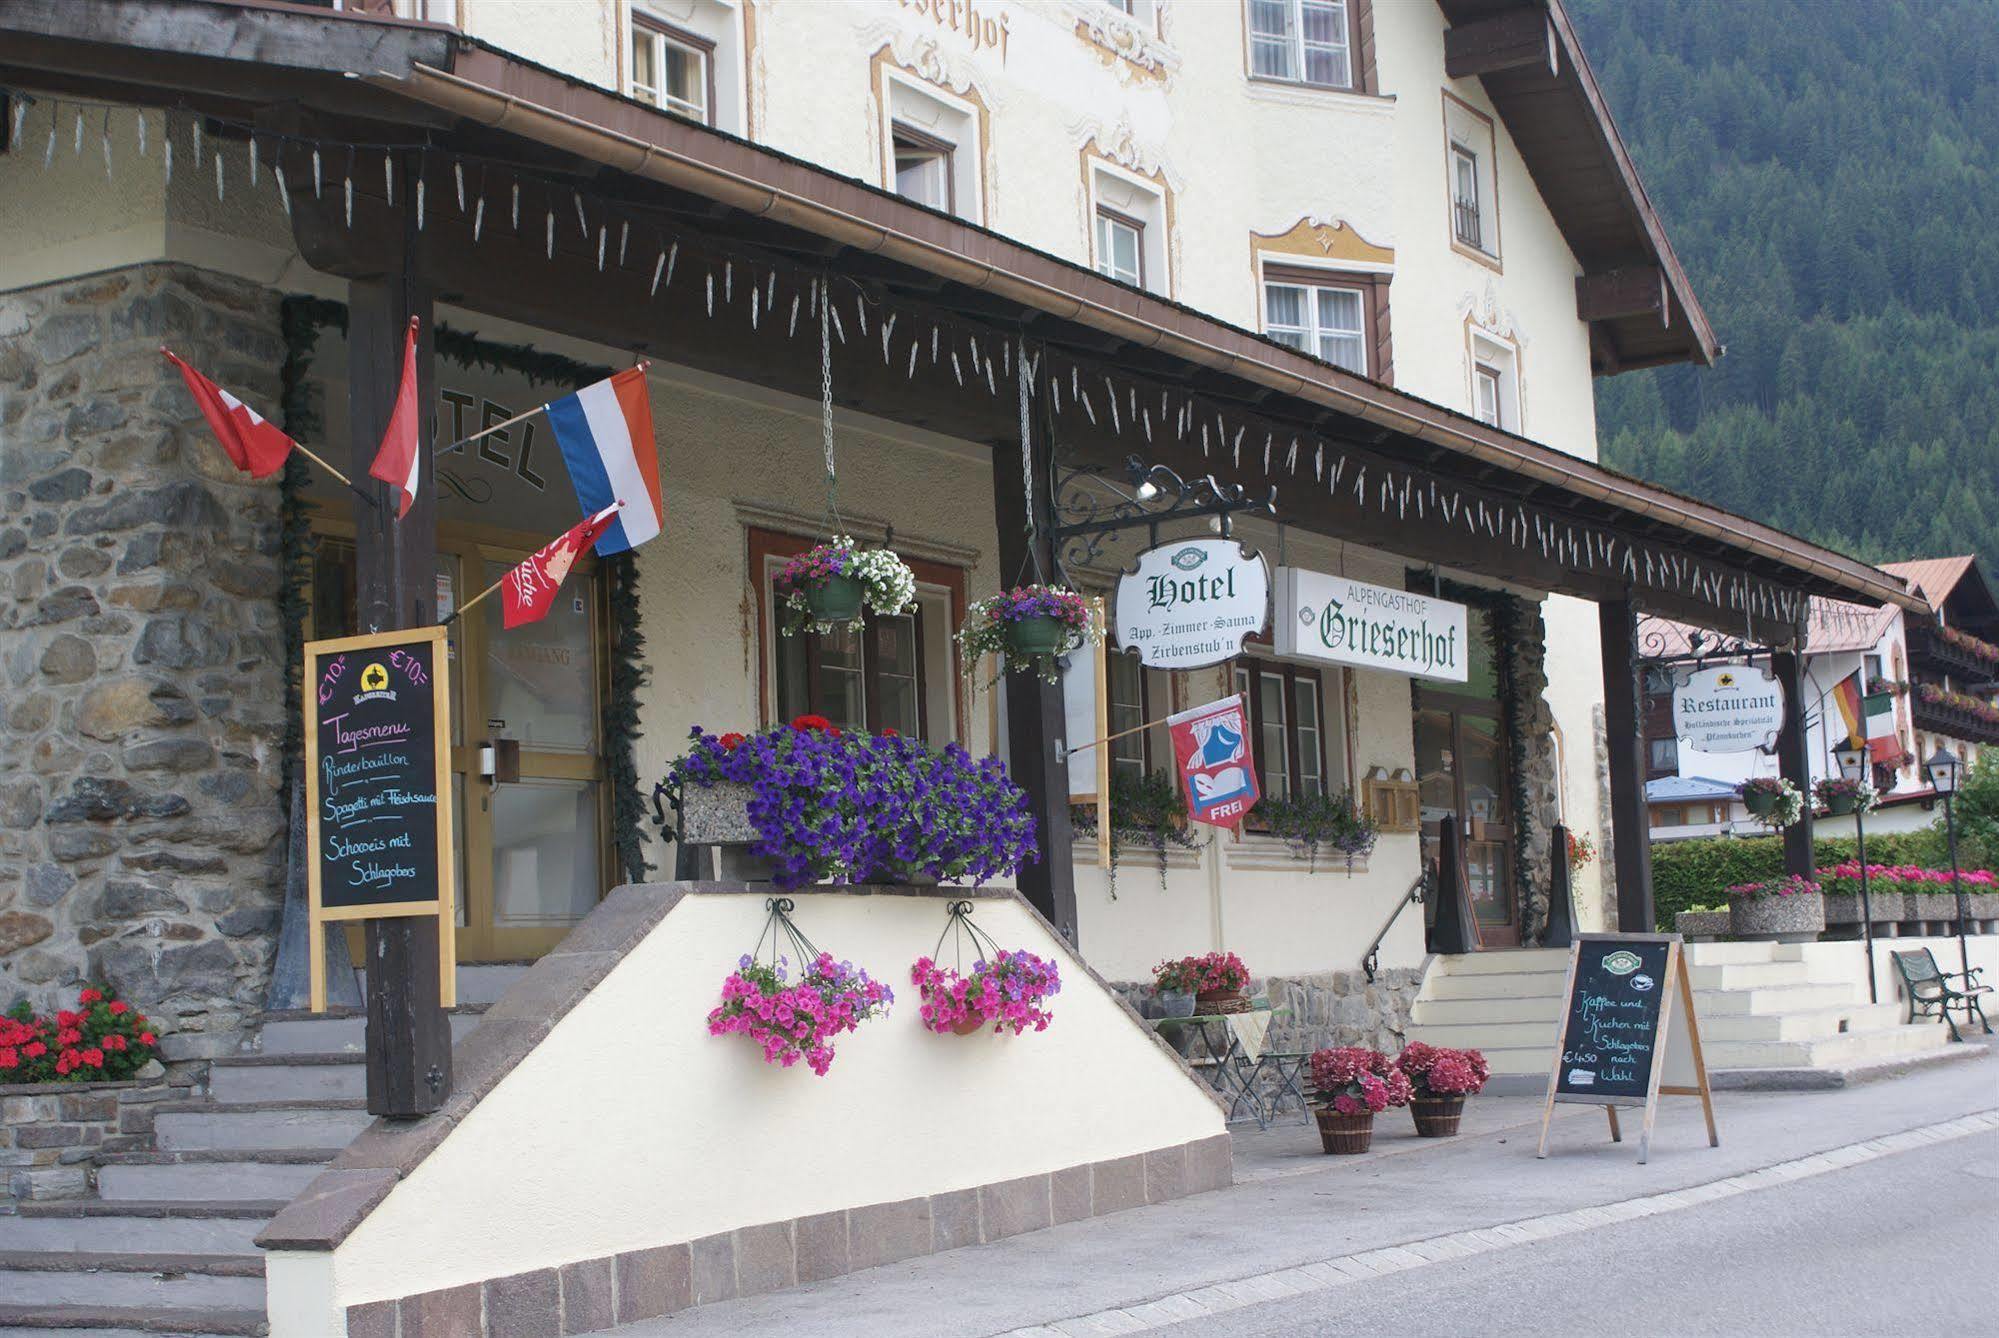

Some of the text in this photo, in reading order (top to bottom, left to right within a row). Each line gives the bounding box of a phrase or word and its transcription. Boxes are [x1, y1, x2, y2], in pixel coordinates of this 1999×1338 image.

[432, 386, 547, 493] TEL
[1146, 566, 1235, 614] Hotel
[1346, 586, 1428, 616] ALPENGASTHOF
[1320, 598, 1456, 674] Grieserhof
[1680, 694, 1776, 714] Restaurant
[370, 794, 386, 807] mit
[1209, 799, 1243, 821] FREI
[389, 832, 412, 848] mit
[1576, 990, 1618, 1021] Kaffee
[1634, 1021, 1651, 1031] mit
